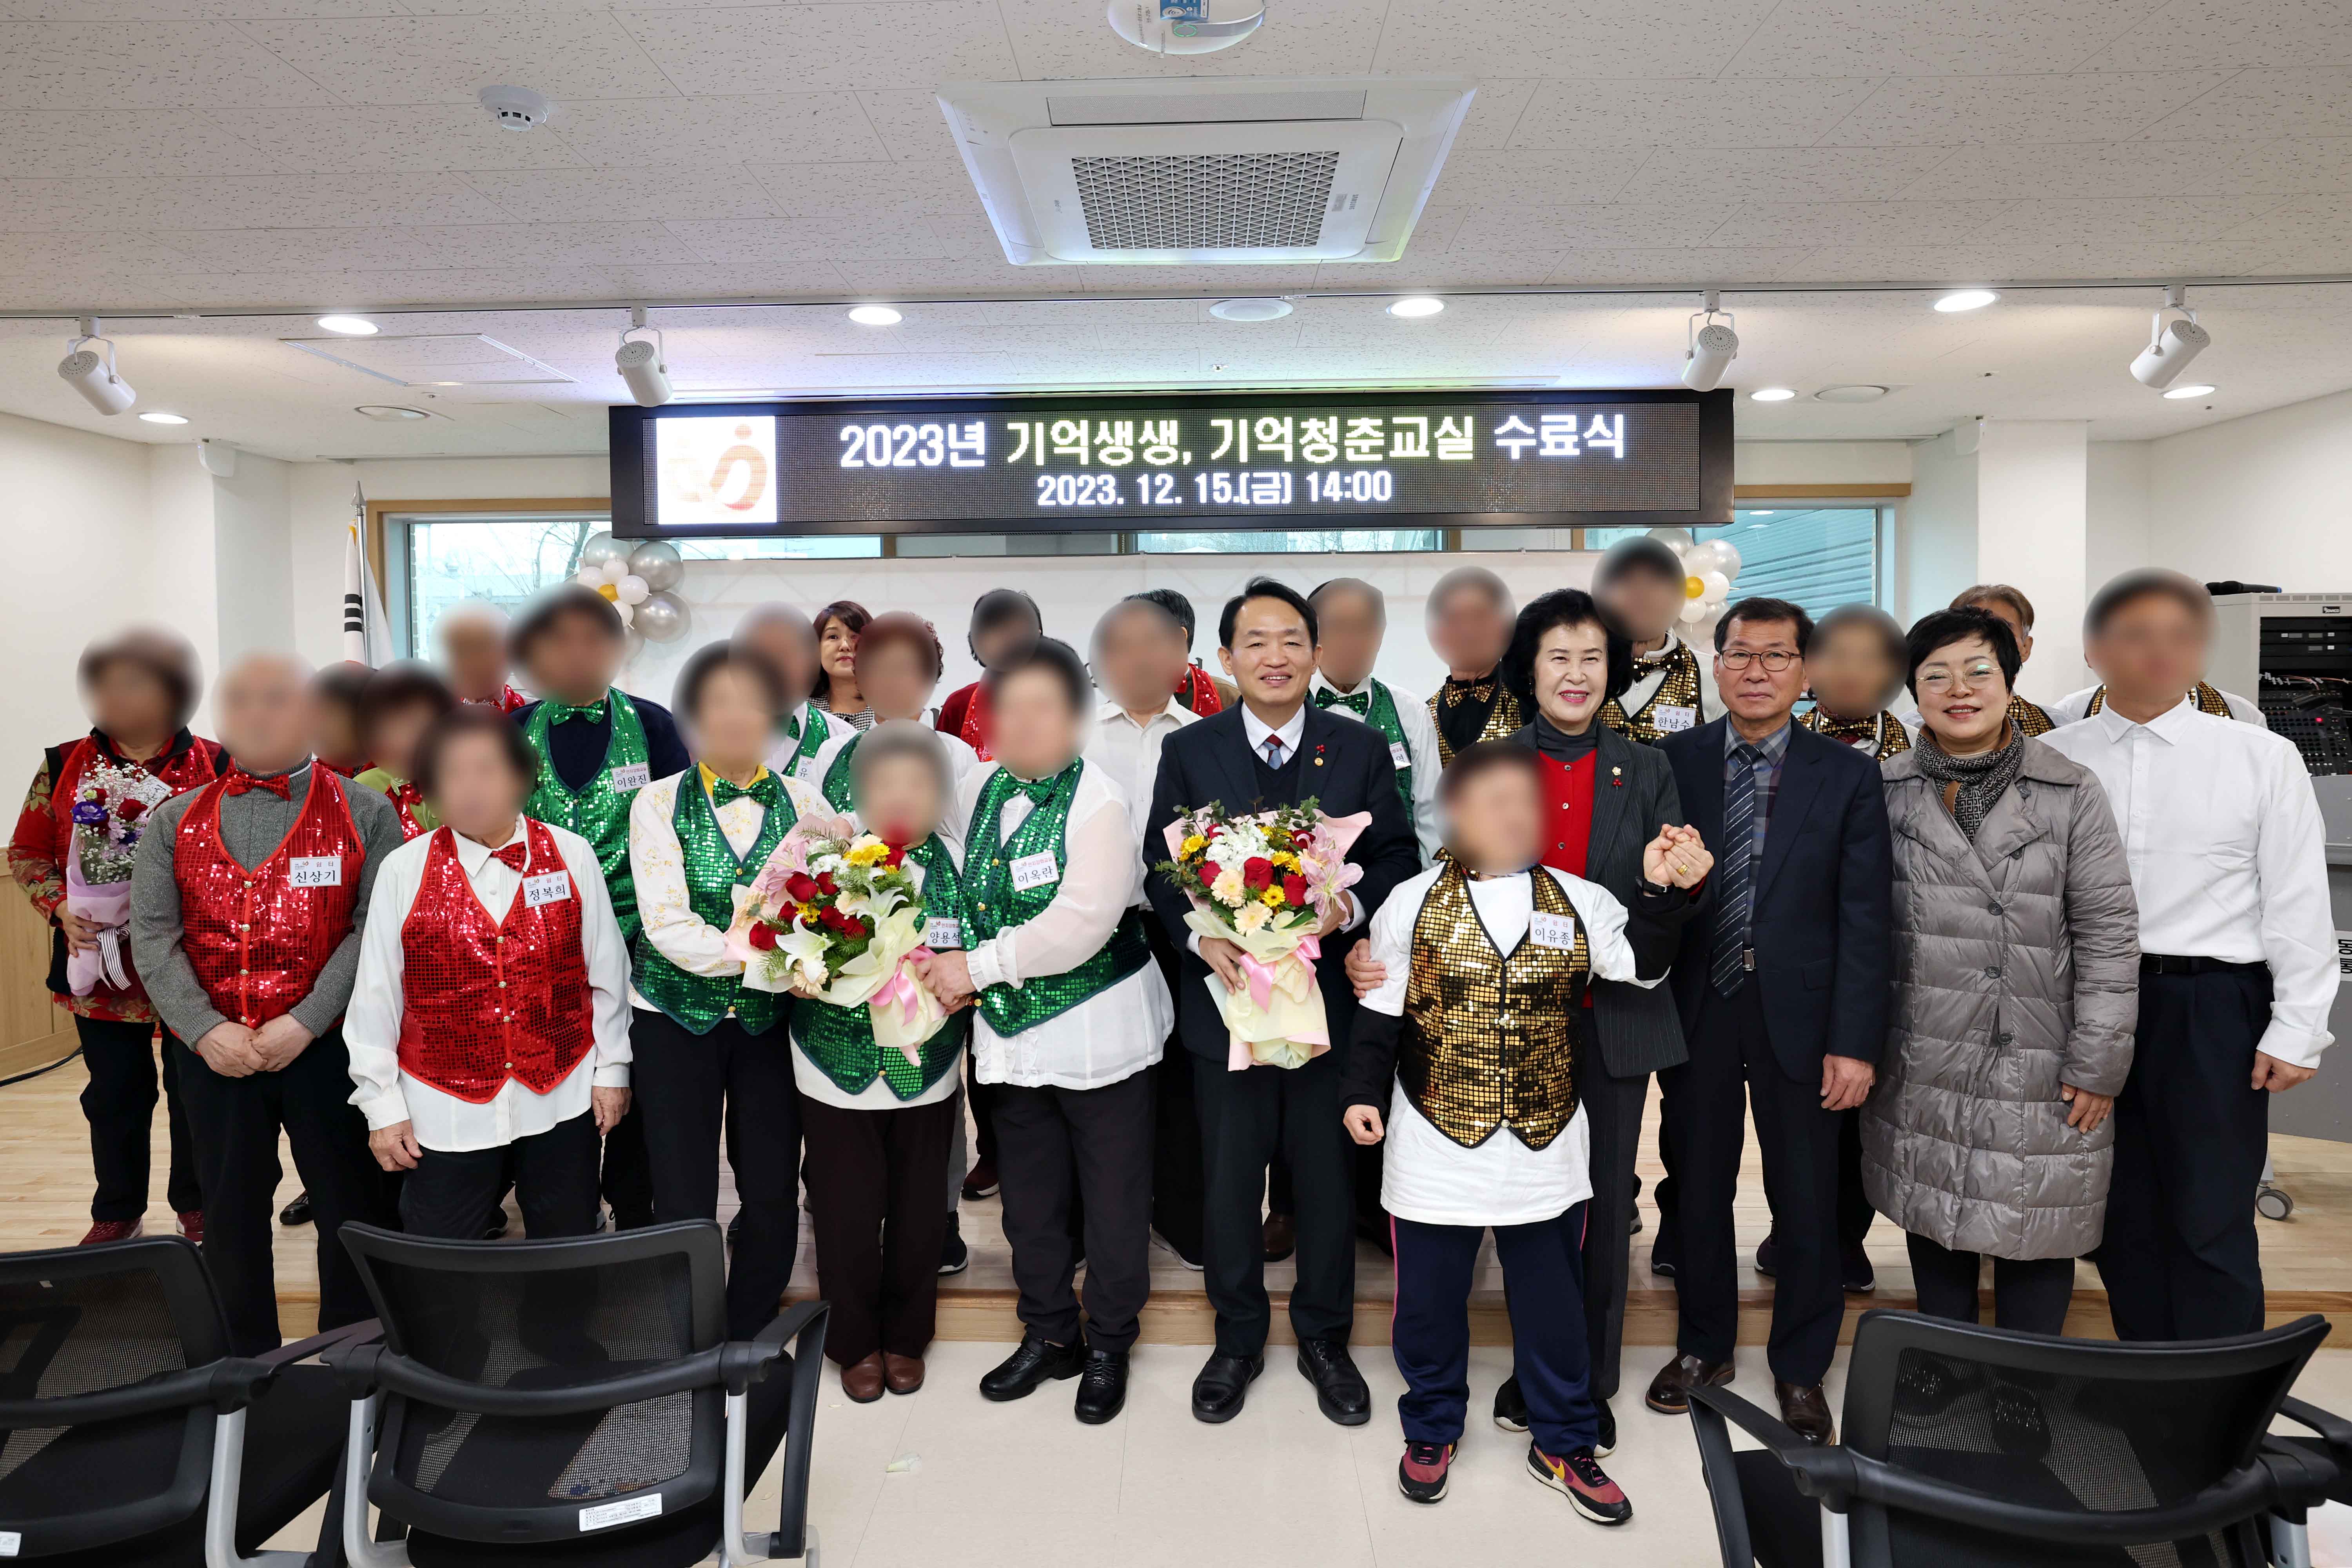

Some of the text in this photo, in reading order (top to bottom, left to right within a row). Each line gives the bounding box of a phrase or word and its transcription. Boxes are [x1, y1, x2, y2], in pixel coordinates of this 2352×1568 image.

[840, 414, 1624, 467] 2023년 기억생생, 기억청춘교실 수료식
[1037, 474, 1124, 505] 2023.
[1137, 473, 1182, 504] 12.
[1306, 470, 1392, 502] 14:00
[1658, 717, 1690, 730] 한남수
[617, 774, 647, 788] 이완진
[295, 870, 335, 883] 신상기
[1018, 866, 1054, 883] 이옥란
[529, 884, 566, 901] 정복희
[930, 931, 960, 944] 양용석
[1535, 927, 1571, 945] 이유종
